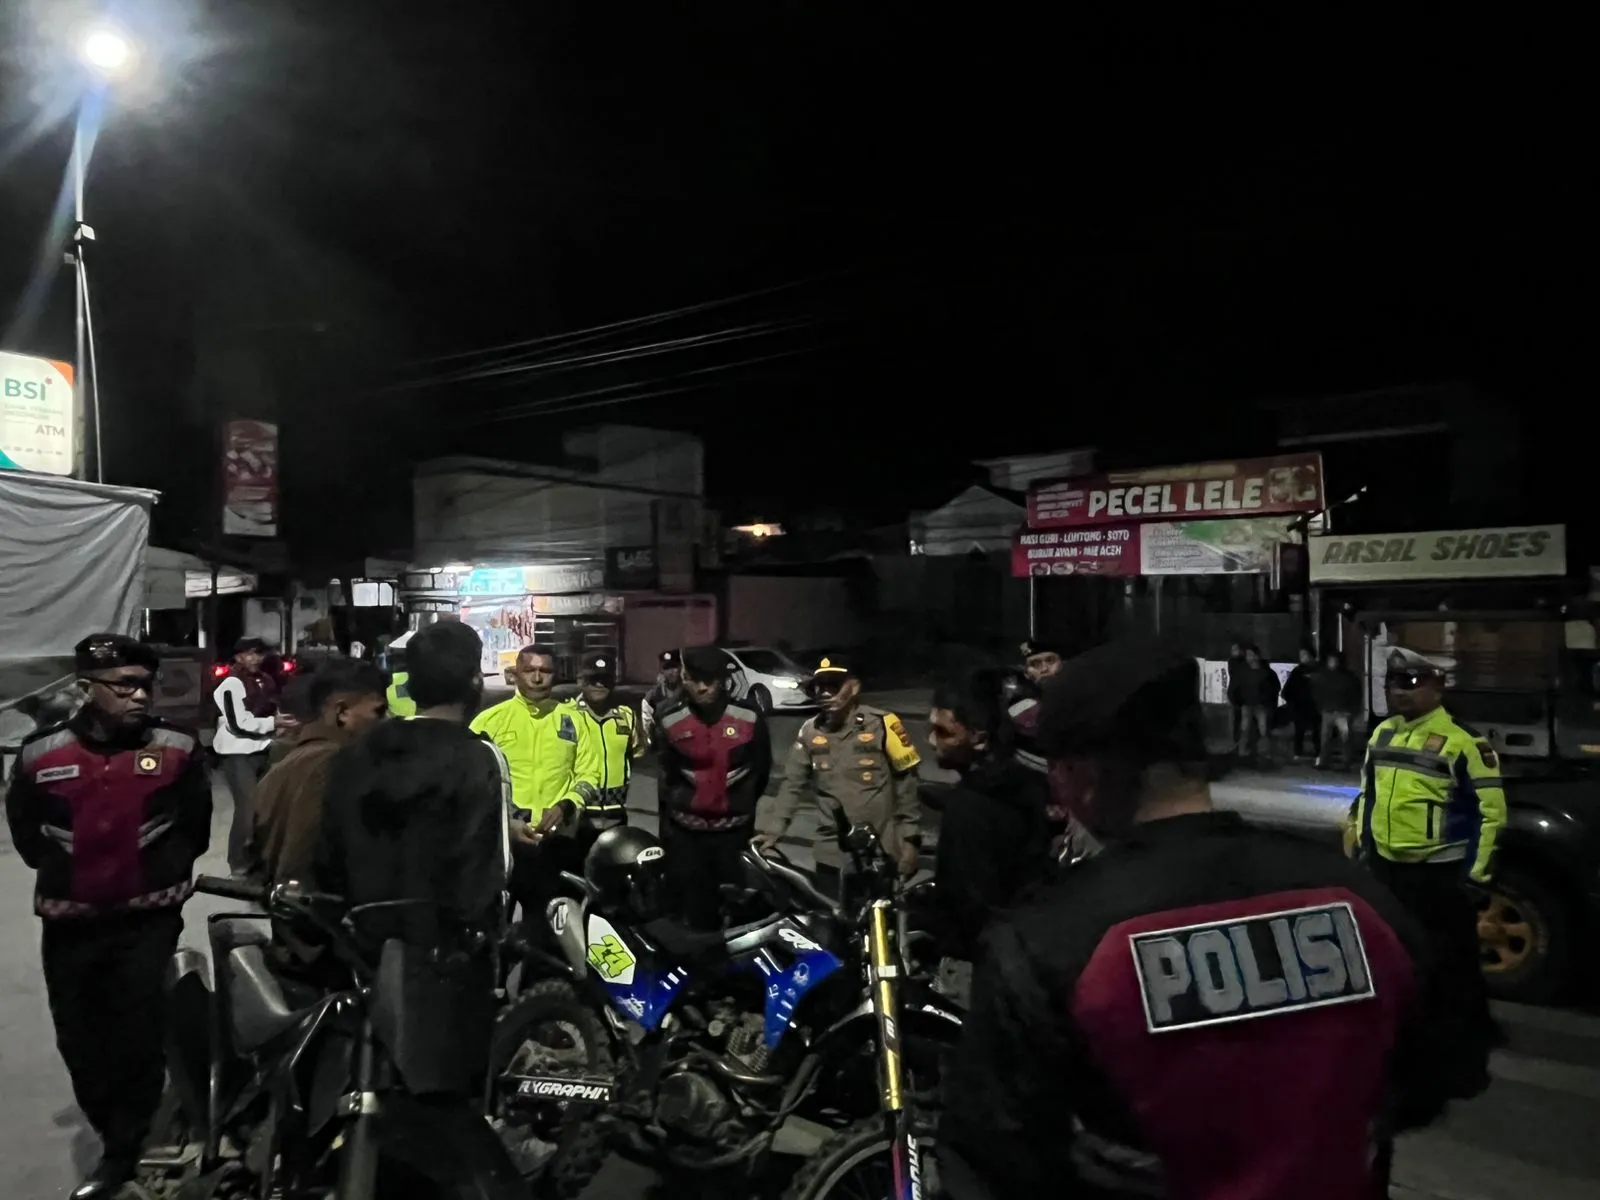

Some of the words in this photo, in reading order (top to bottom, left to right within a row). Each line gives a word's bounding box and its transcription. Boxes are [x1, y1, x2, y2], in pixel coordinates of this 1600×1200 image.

[4, 377, 48, 401] BSI
[35, 424, 65, 437] ATM
[1088, 483, 1177, 517] PECEL
[1185, 477, 1264, 511] LELE
[1107, 529, 1129, 541] SOTO
[1100, 545, 1121, 556] ACEH
[1322, 538, 1416, 564] ARSAL
[1430, 531, 1550, 560] SHOES
[1137, 907, 1367, 1023] POLISI
